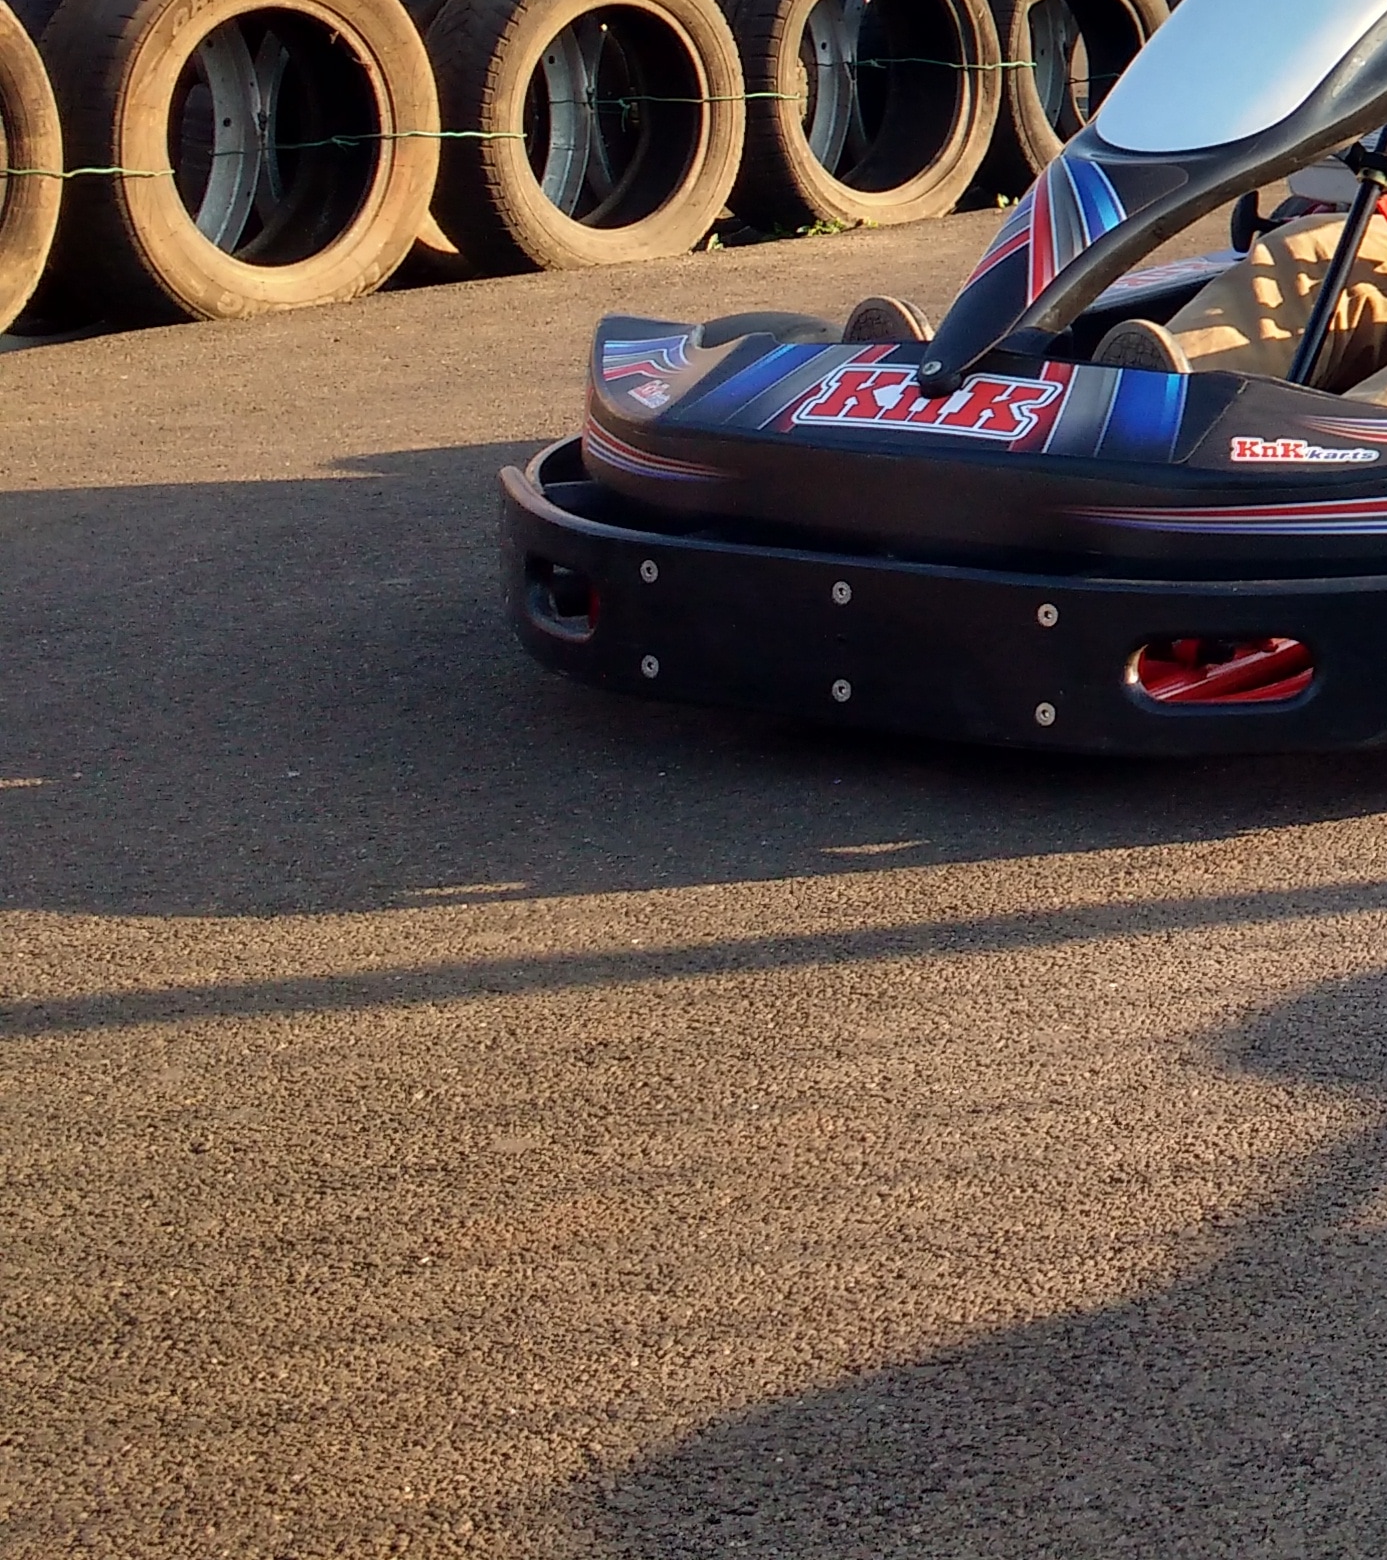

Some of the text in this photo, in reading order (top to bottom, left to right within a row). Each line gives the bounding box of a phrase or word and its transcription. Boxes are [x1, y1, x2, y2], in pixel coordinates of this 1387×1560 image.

[806, 371, 1053, 432] KnK
[1236, 440, 1375, 460] KnK karts
